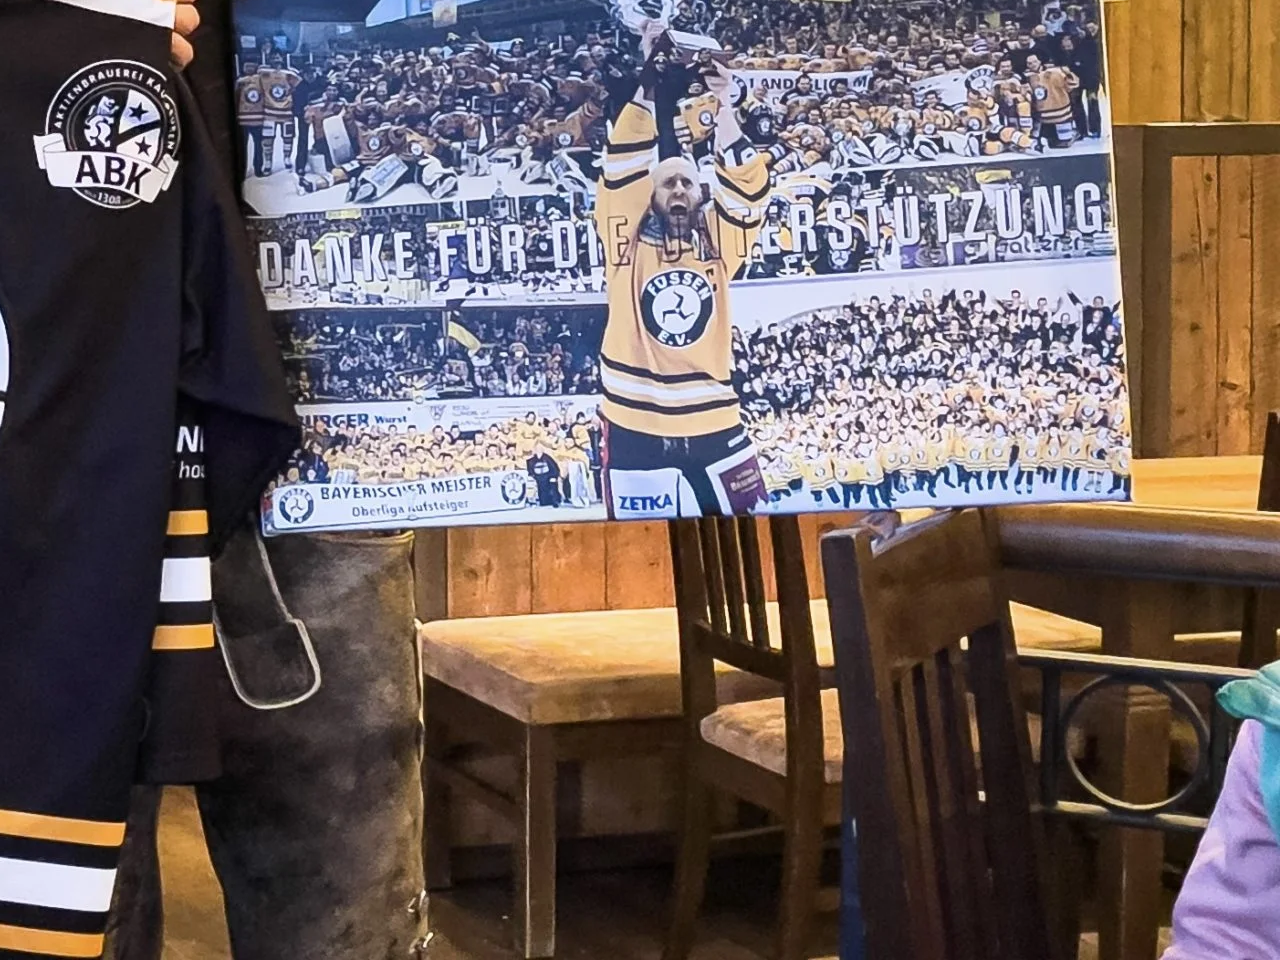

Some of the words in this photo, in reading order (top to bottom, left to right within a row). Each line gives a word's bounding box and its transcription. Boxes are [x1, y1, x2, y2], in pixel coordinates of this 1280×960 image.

[53, 67, 144, 130] AKTIENBRAUEREI
[75, 154, 151, 196] ABK
[259, 231, 415, 288] DANKE
[439, 216, 527, 277] FÜR
[552, 216, 631, 269] DIE
[646, 272, 712, 301] FUSSEN
[657, 330, 693, 346] E.V.
[375, 415, 407, 424] Wurst
[431, 477, 492, 495] MEISTER
[352, 503, 405, 517] Oberliga
[619, 493, 673, 511] ZETKA
